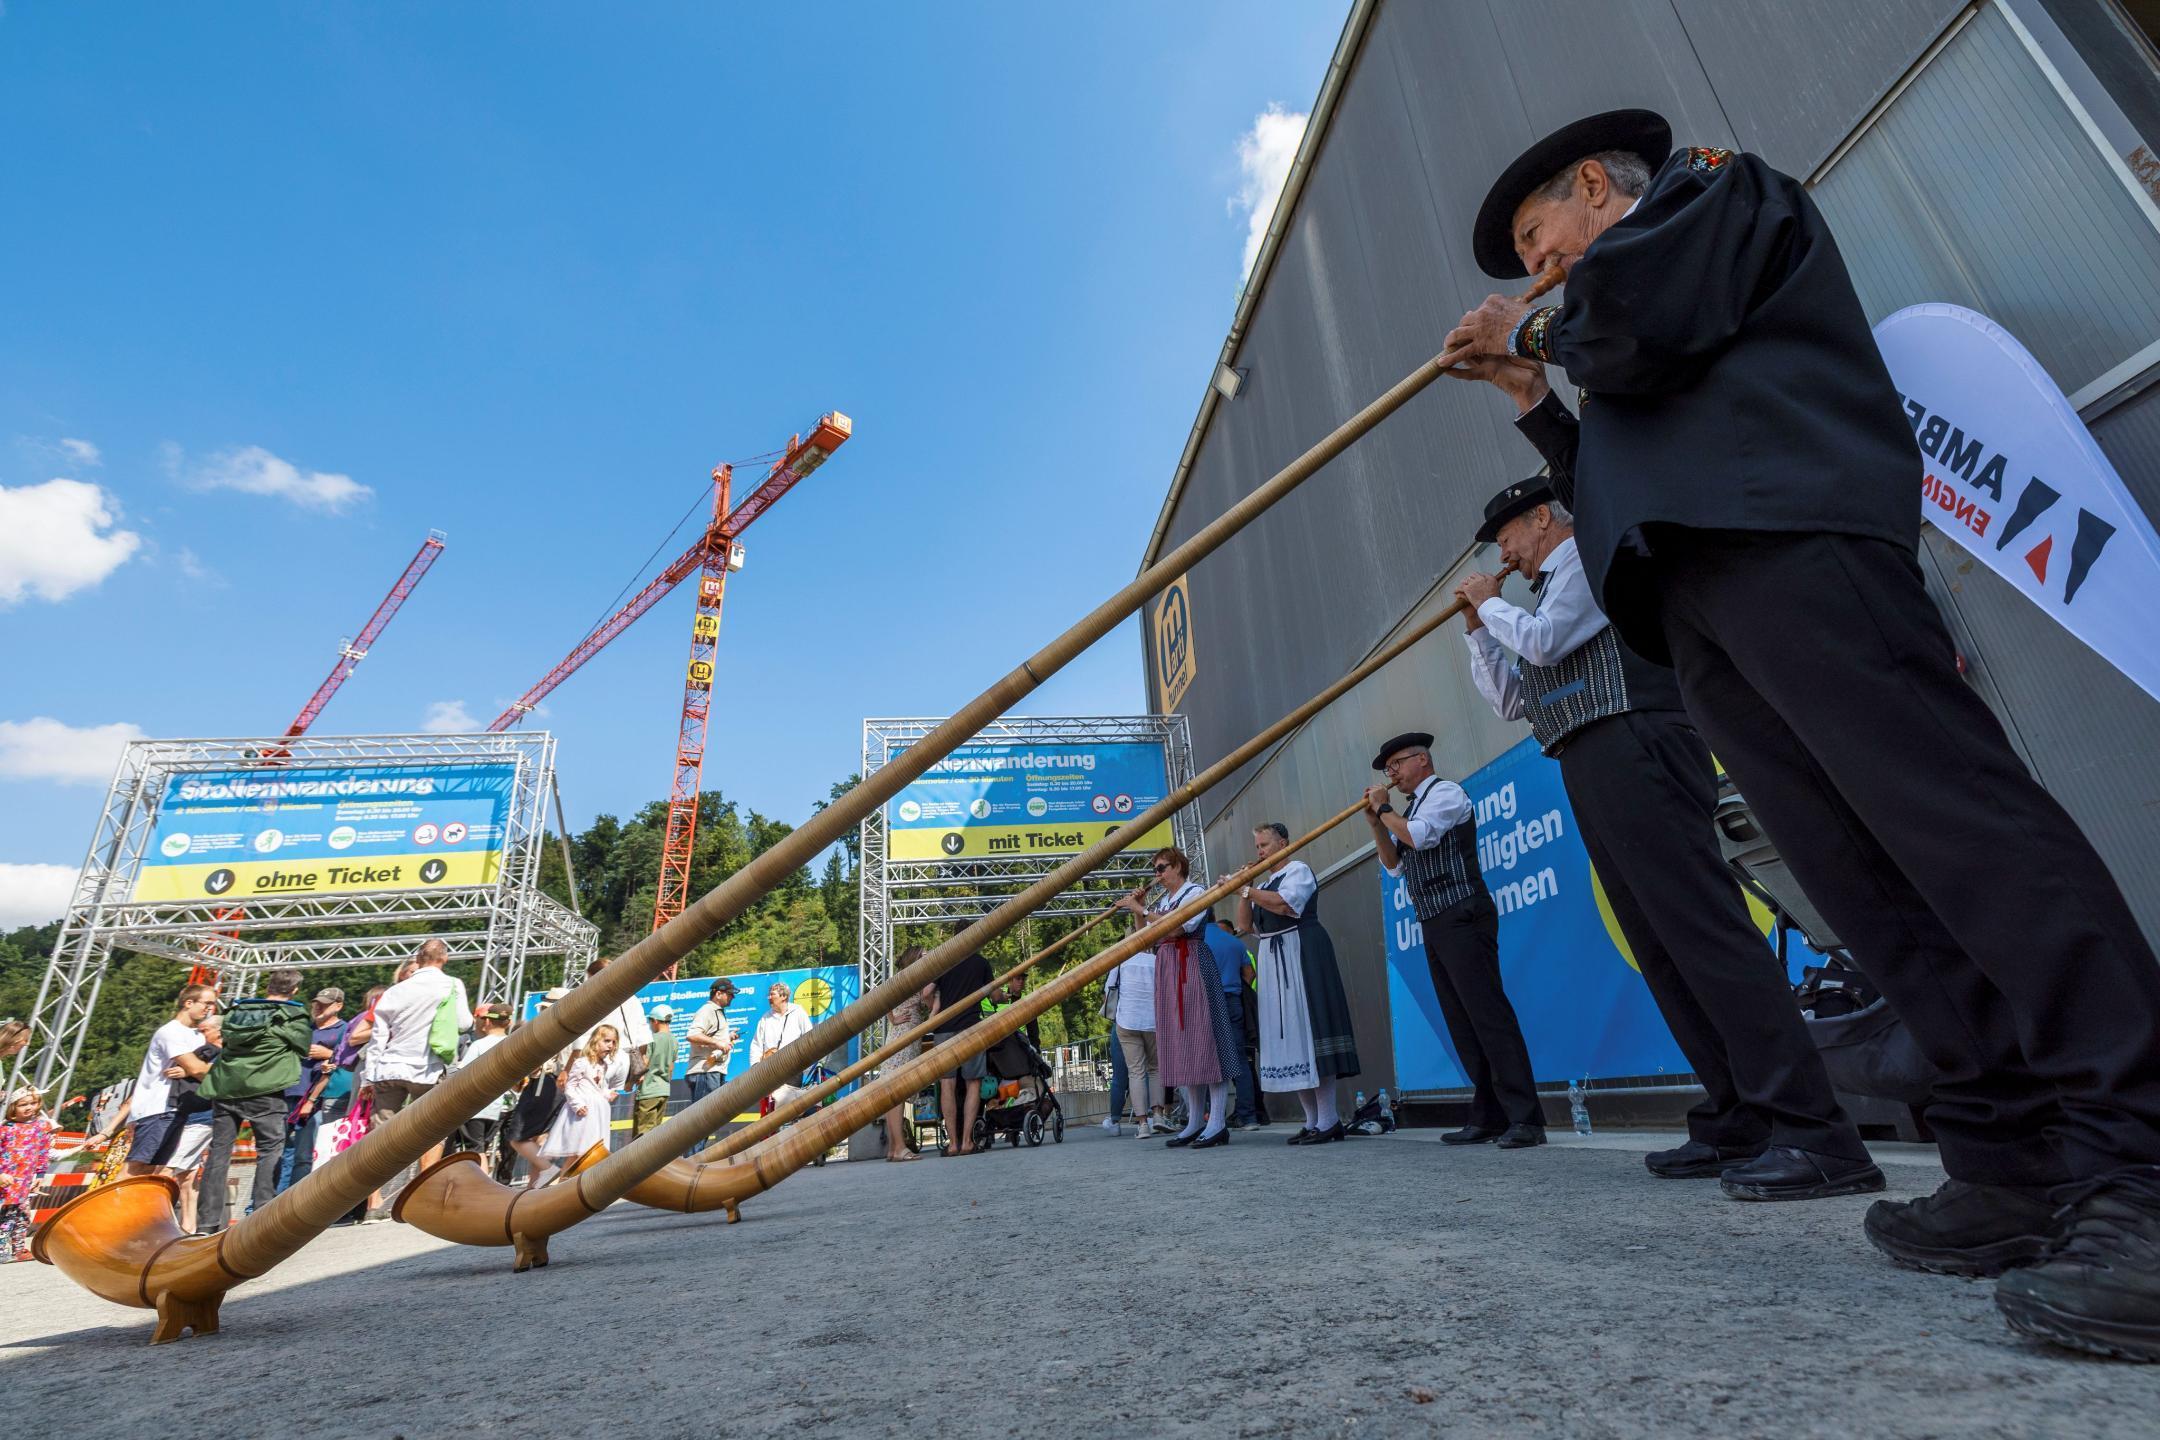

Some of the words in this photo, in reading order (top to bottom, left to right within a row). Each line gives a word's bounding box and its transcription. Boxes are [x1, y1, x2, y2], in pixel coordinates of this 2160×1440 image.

[1168, 661, 1188, 708] tunnel
[179, 776, 434, 800] Stollenwanderung
[1025, 774, 1085, 782] Öffnungszeiten
[1473, 781, 1517, 828] ung
[988, 834, 1020, 850] mit
[1025, 832, 1084, 847] Ticket
[1477, 809, 1563, 873] iligten
[255, 871, 318, 889] ohne
[328, 866, 402, 885] Ticket
[652, 994, 669, 1002] zur
